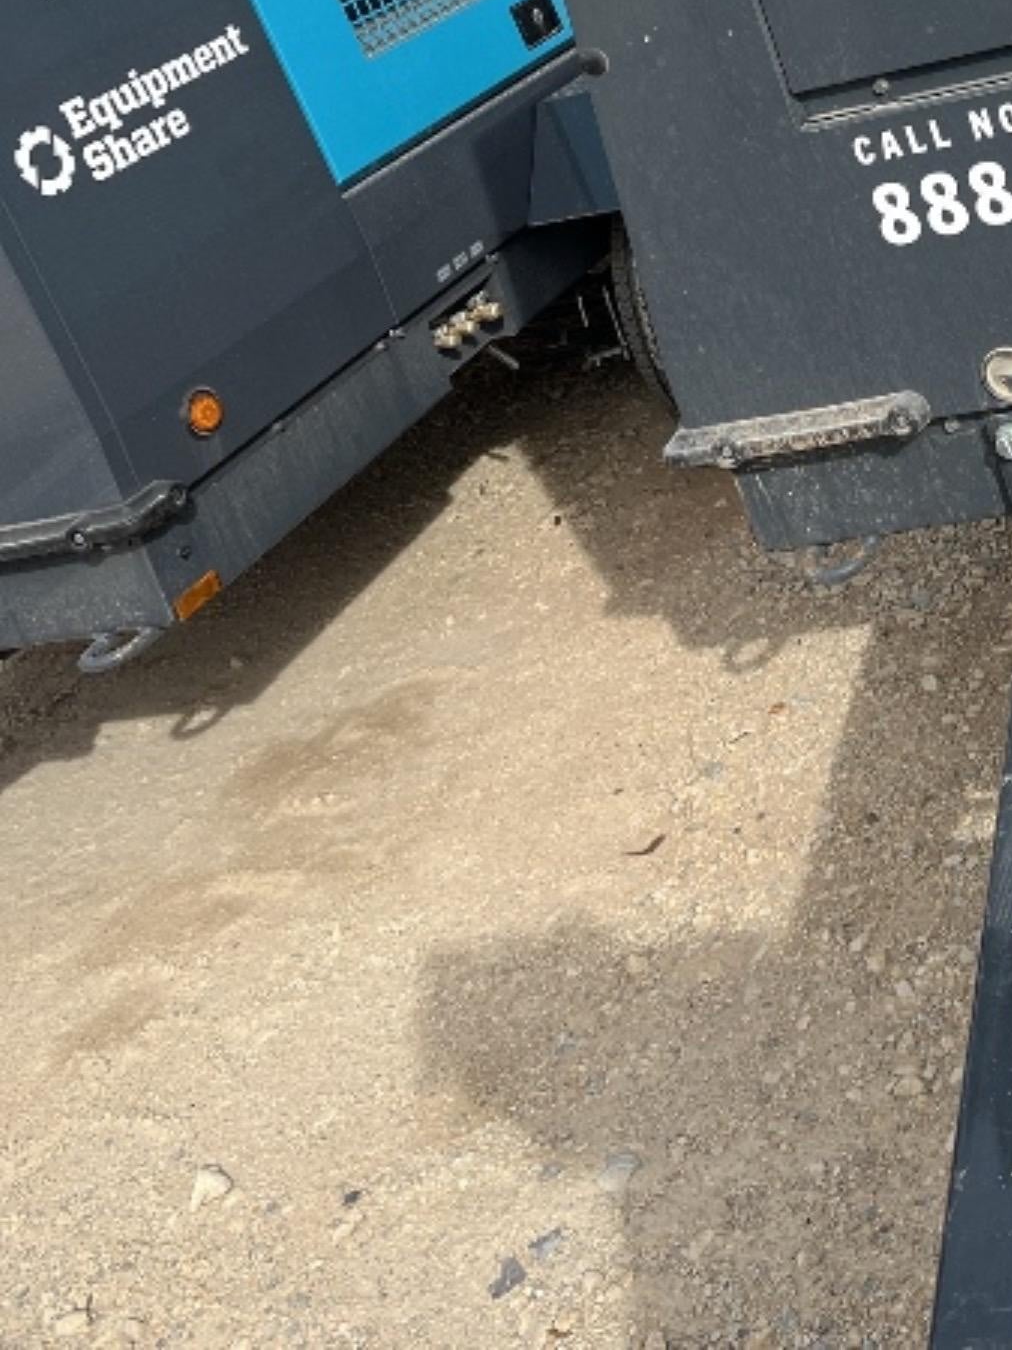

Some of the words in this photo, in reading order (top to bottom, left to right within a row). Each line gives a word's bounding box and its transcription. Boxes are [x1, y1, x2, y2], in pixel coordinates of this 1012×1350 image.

[58, 23, 249, 139] Equipment
[82, 108, 191, 181] Share
[854, 119, 951, 166] CALL
